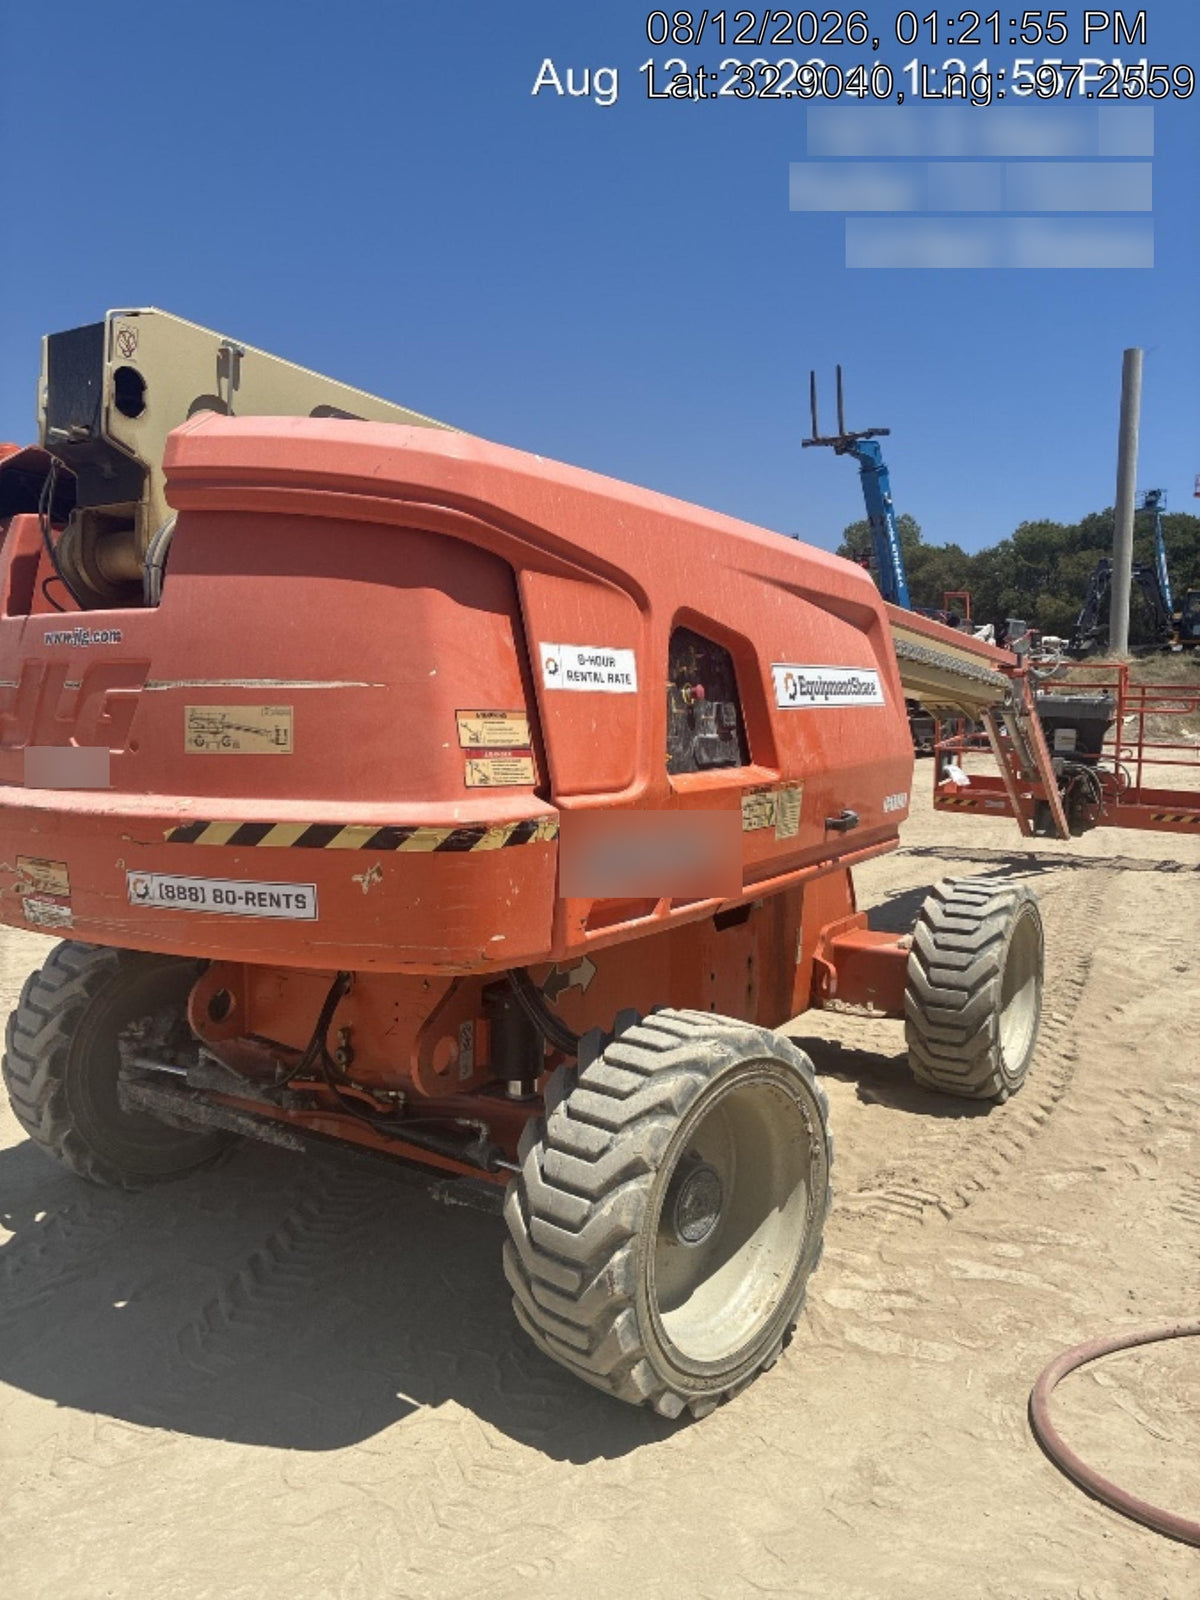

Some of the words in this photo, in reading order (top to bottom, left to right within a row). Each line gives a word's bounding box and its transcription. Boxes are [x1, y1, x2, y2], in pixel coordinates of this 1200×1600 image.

[44, 627, 123, 647] www.jlg.com
[566, 669, 605, 684] RENTAL
[607, 673, 632, 686] RATE
[159, 883, 206, 904] (888)
[212, 888, 307, 910] 80-RENTS
